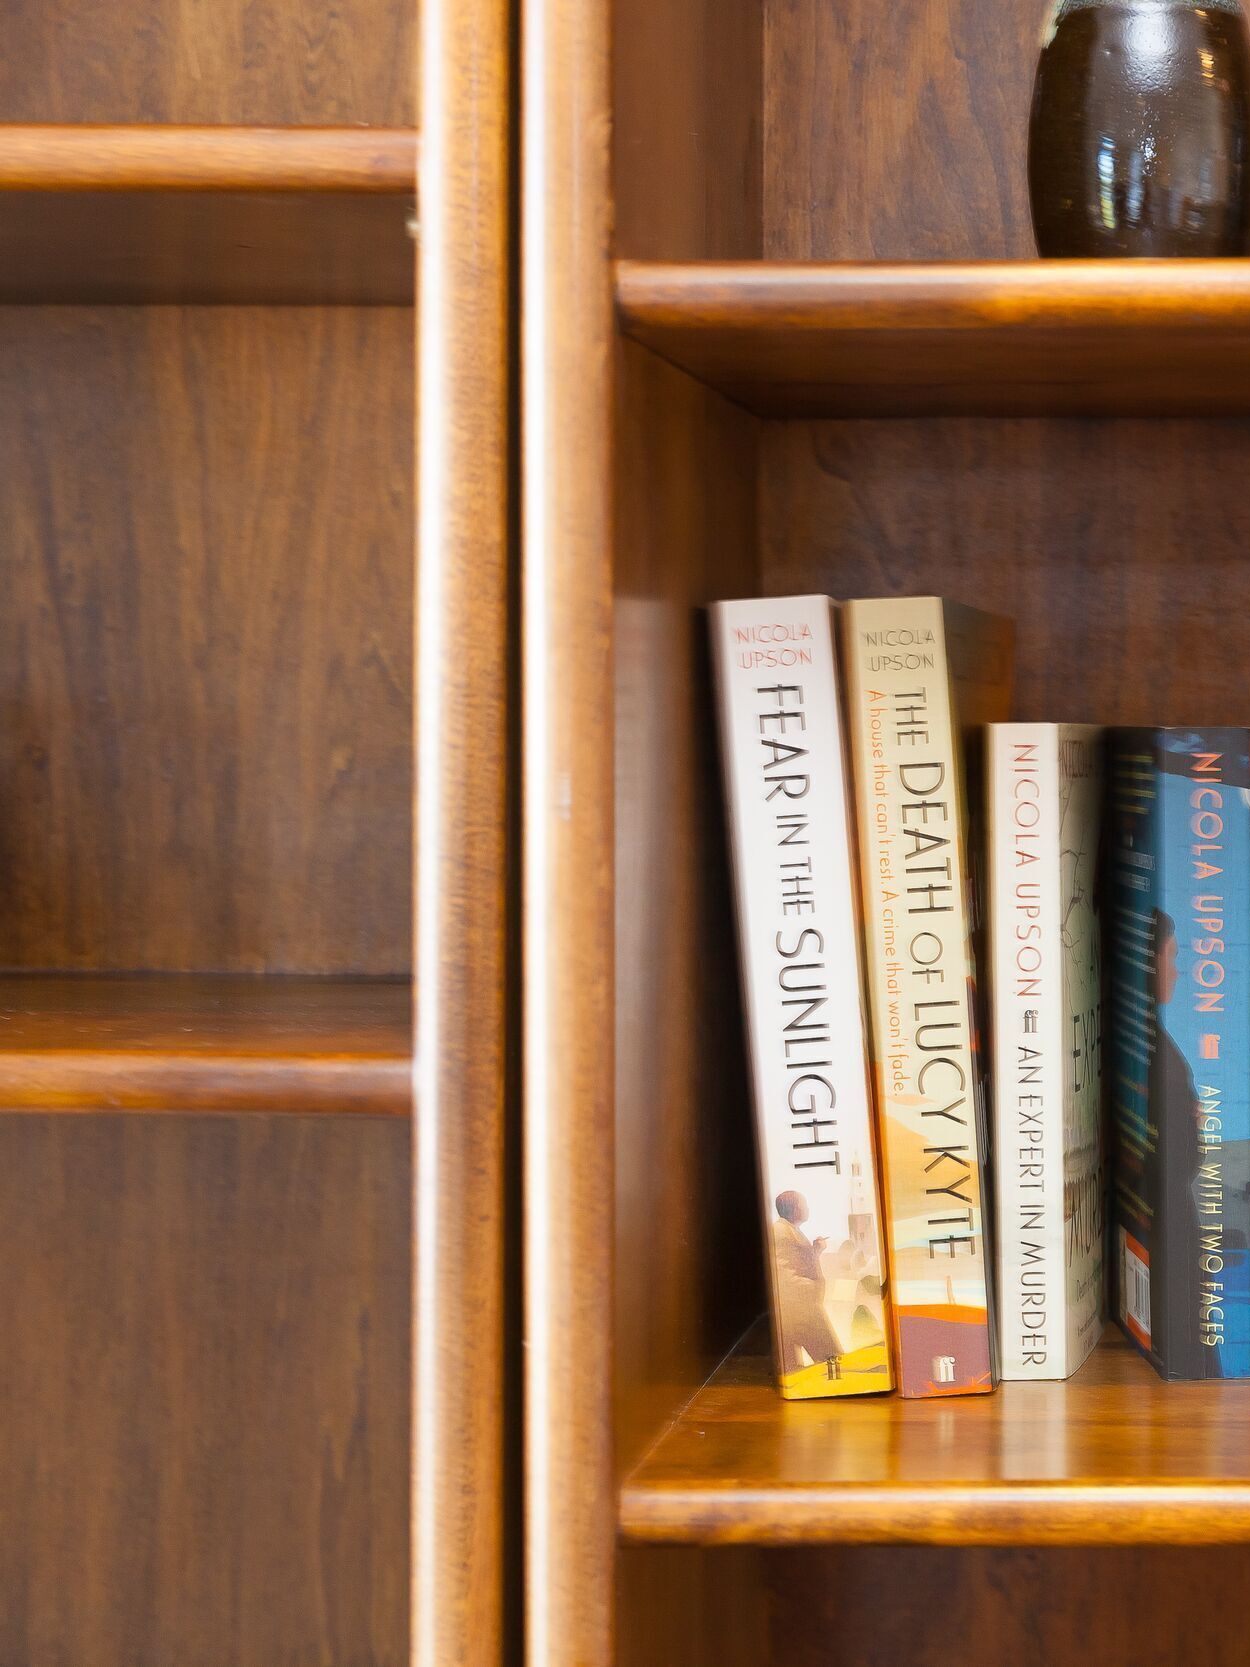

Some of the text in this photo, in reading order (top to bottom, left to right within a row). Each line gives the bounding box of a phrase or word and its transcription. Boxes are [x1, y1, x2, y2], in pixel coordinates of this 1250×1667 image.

[736, 624, 813, 645] NICOLA
[739, 648, 813, 669] UPSON
[864, 629, 936, 648] NICOLA
[868, 653, 935, 672] UPSON
[757, 684, 840, 1175] FEAR IN THE SUNLIGHT
[864, 689, 911, 1097] A house that can't rest. A crime that won't fade.
[895, 687, 975, 1259] THE DEATH OF LUCY KYTE
[1013, 743, 1042, 997] NICOLA UPSON
[1191, 752, 1225, 1012] NICOLA UPSON
[1018, 1046, 1047, 1366] AN EXPERT IN MURDER
[1198, 1085, 1224, 1346] ANGEL WITH TWO FACES
